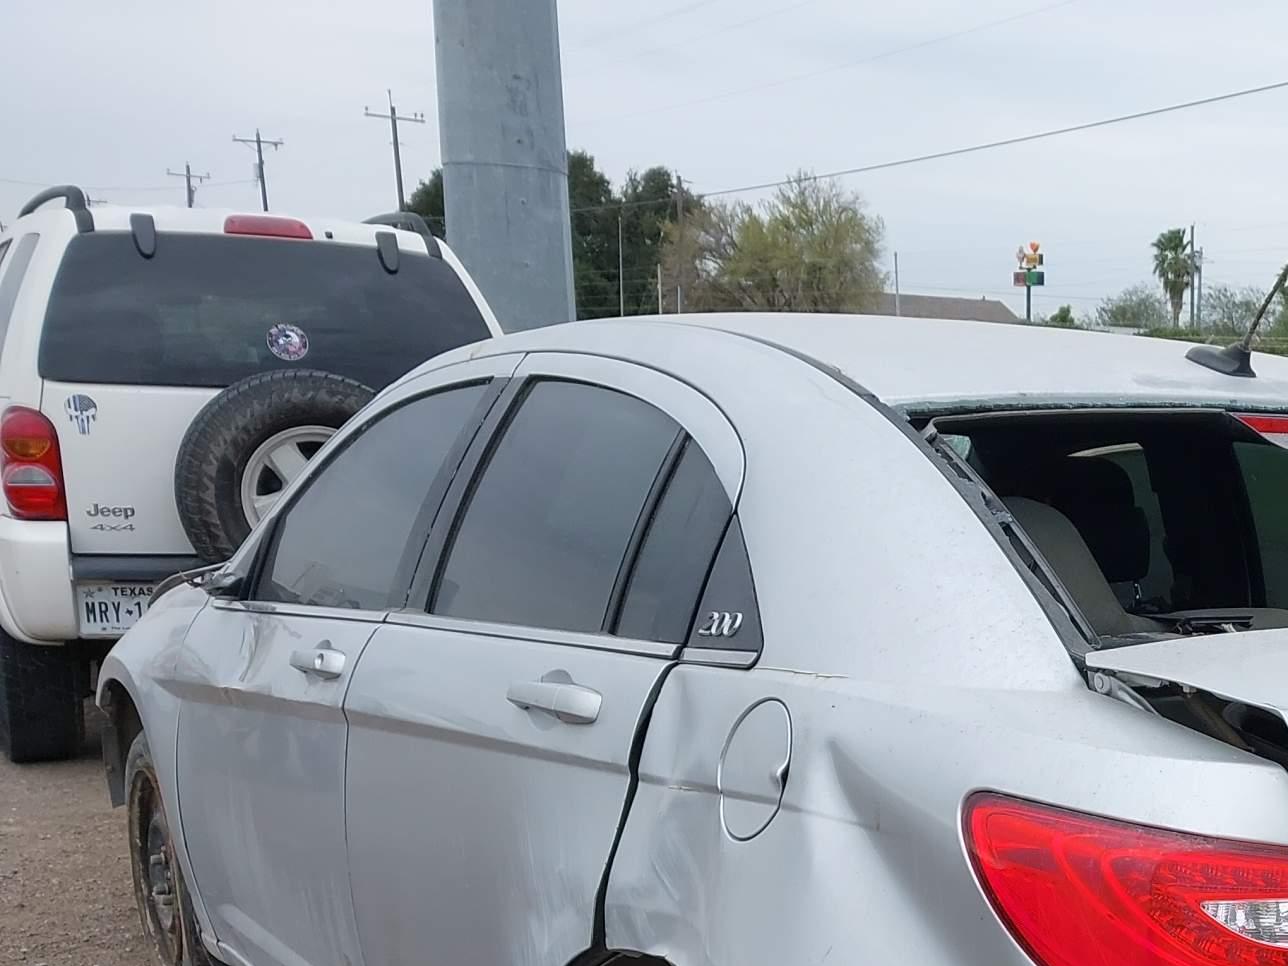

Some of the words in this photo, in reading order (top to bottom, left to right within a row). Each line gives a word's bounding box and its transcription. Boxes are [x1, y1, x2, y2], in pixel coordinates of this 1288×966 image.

[86, 503, 136, 520] Jeep
[111, 586, 154, 597] TEXAS
[697, 611, 744, 638] 200
